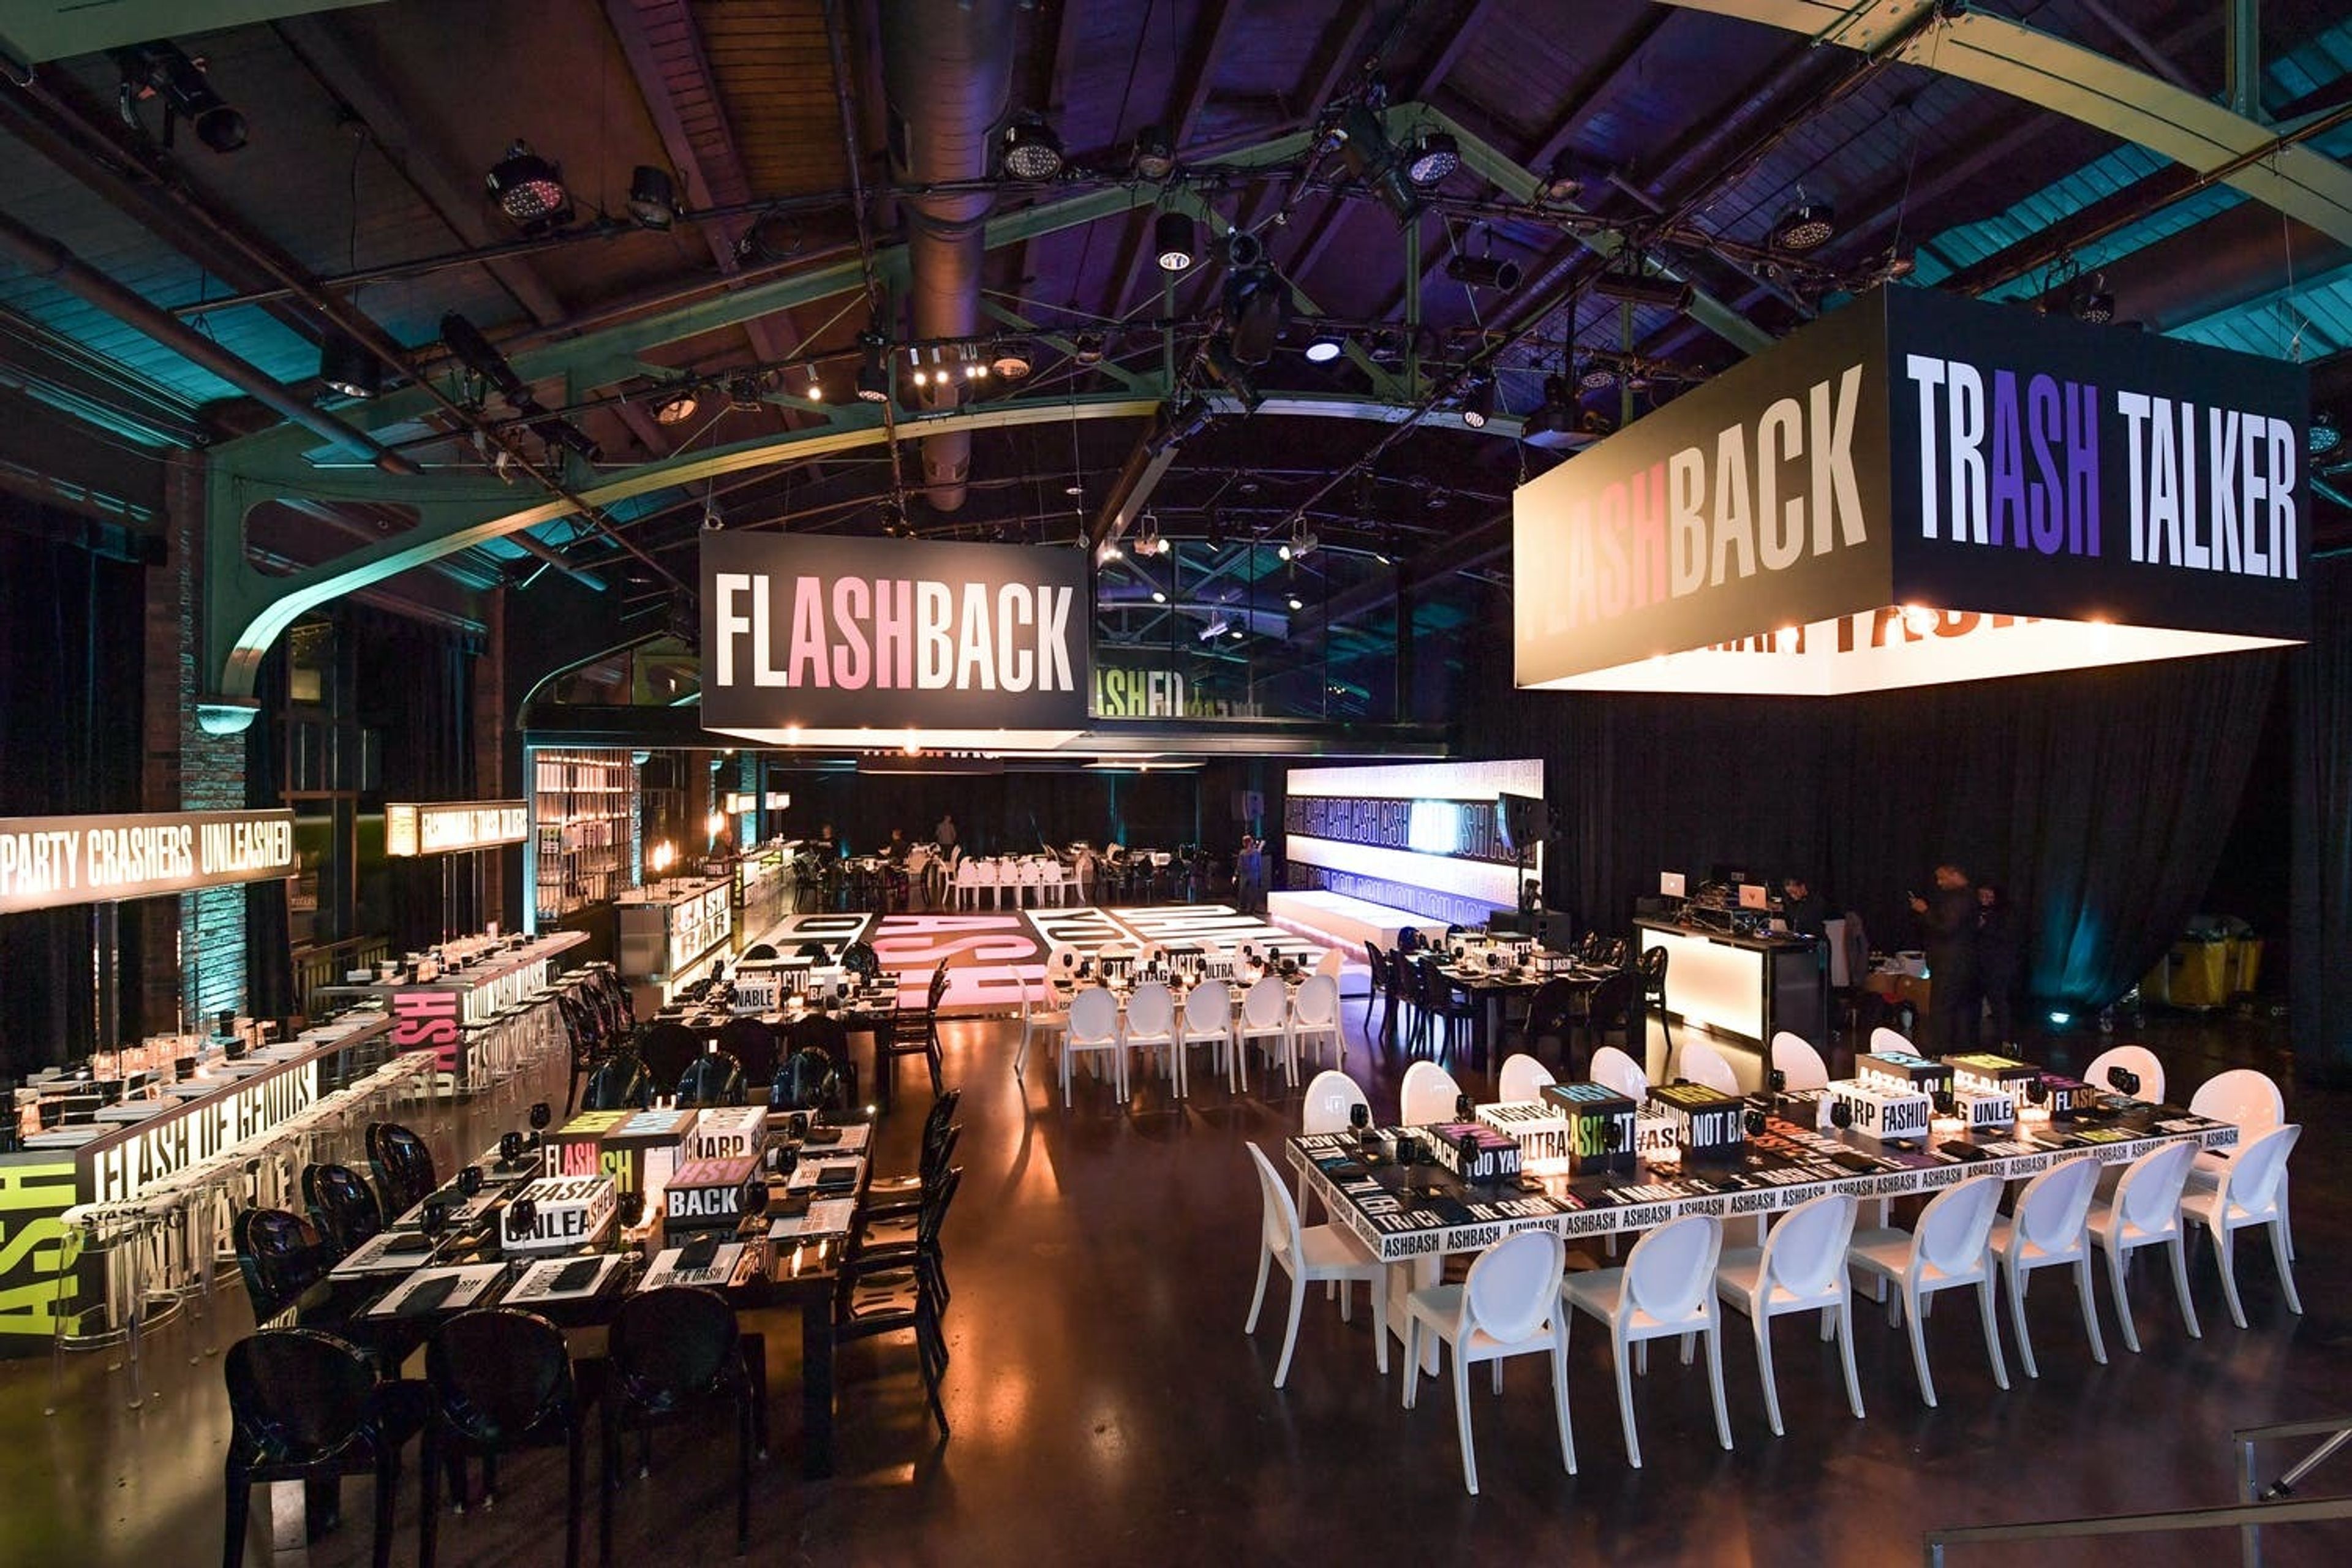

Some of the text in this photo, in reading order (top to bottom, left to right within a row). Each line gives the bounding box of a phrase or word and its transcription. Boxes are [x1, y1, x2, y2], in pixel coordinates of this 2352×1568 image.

[1907, 353, 2299, 581] TRASH TALKER
[1521, 363, 1868, 641] FLASHBACK
[715, 573, 1074, 693] FLASHBACK
[1352, 799, 1379, 843] ASH
[1380, 801, 1411, 847] ASH
[0, 820, 292, 897] PARTY CRASHERS UNLEASHED
[679, 884, 726, 935] CASH
[680, 913, 726, 959] BAR
[101, 1061, 311, 1204] FLASH OF GENIUS
[1692, 1112, 1724, 1147] NOT
[1973, 1100, 2014, 1124] UNLE
[545, 1142, 597, 1178] FLASH
[669, 1187, 739, 1218] BACK
[1384, 1232, 1439, 1257] ASHBASH
[1447, 1226, 1500, 1251] ASHBASH
[1566, 1212, 1616, 1235] ASHBASH
[1623, 1205, 1671, 1227] ASHBASH
[1731, 1192, 1776, 1213] ASHBASH
[1877, 1175, 1917, 1194] ASHBASH
[1922, 1166, 1962, 1189] ASHBASH
[2010, 1155, 2048, 1175] ASHBASH
[2206, 1128, 2239, 1145] ASHBASH
[680, 1270, 689, 1283] &
